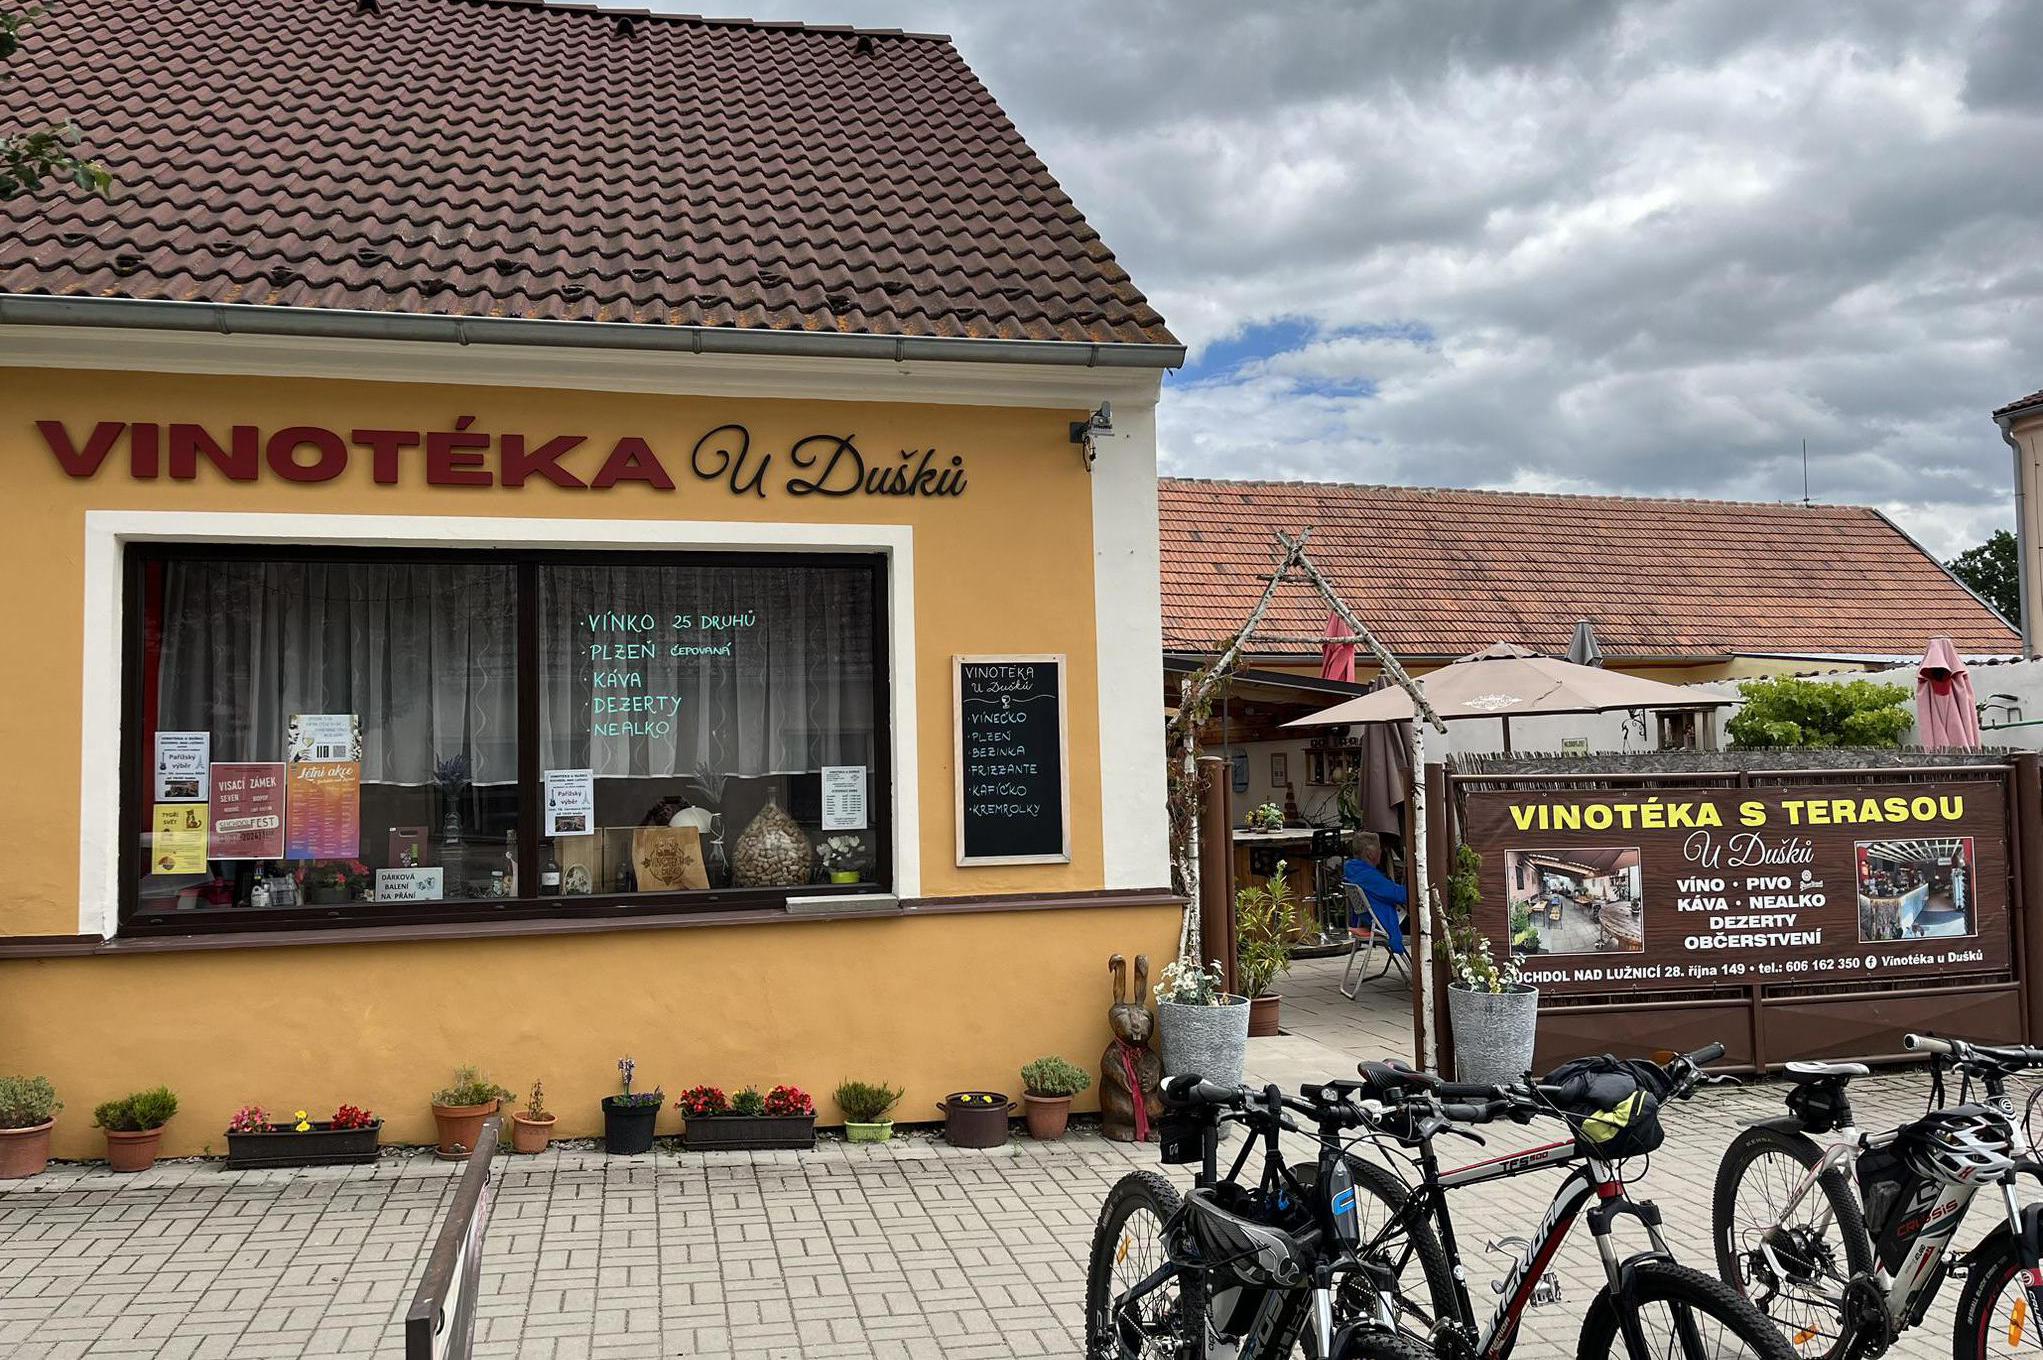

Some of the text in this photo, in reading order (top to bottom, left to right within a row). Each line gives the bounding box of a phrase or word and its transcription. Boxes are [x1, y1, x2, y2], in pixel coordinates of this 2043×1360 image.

[34, 416, 968, 498] VINOTÉKA U Dušků
[588, 609, 756, 633] VÍNKO 25 DRUHŮ
[590, 640, 656, 661] PLZEŇ
[593, 668, 642, 689] KÁVA
[965, 665, 1034, 680] VINOTÉKA
[971, 680, 1034, 693] U Dušků
[594, 695, 682, 717] DEZERTY
[971, 711, 1027, 724] VÍNEČKO
[594, 721, 670, 739] NEALKO
[972, 730, 1012, 742] PLZEŇ
[972, 745, 1025, 758] BEZINKA
[971, 763, 1038, 776] FRIZZANTE
[249, 774, 277, 789] ZÁMEK
[972, 782, 1027, 797] KAFÍČKO
[973, 803, 1041, 817] KREMROLKY
[1508, 796, 1964, 831] VINOTÉKA S TERASOU
[1683, 830, 1815, 869] U Dušků
[1676, 876, 1726, 893] VÍNO
[1746, 876, 1792, 891] PIVO
[1677, 893, 1826, 912] KÁVA NEALKO
[1709, 914, 1797, 930] DEZERTY
[1684, 928, 1822, 950] OBČERSTVENÍ
[1574, 968, 1602, 981] NAD
[1607, 964, 1661, 980] LUŽNICÍ
[1664, 965, 1684, 978] 28.
[1688, 964, 1717, 980] října
[1721, 963, 1745, 975] 149
[1759, 962, 1783, 974] tel.:
[1785, 960, 1808, 972] 606
[1811, 959, 1834, 971] 162
[1838, 957, 1860, 969] 350
[1881, 953, 1934, 967] Vinotéka
[1937, 954, 1944, 963] u
[1947, 949, 1983, 963] Dušků
